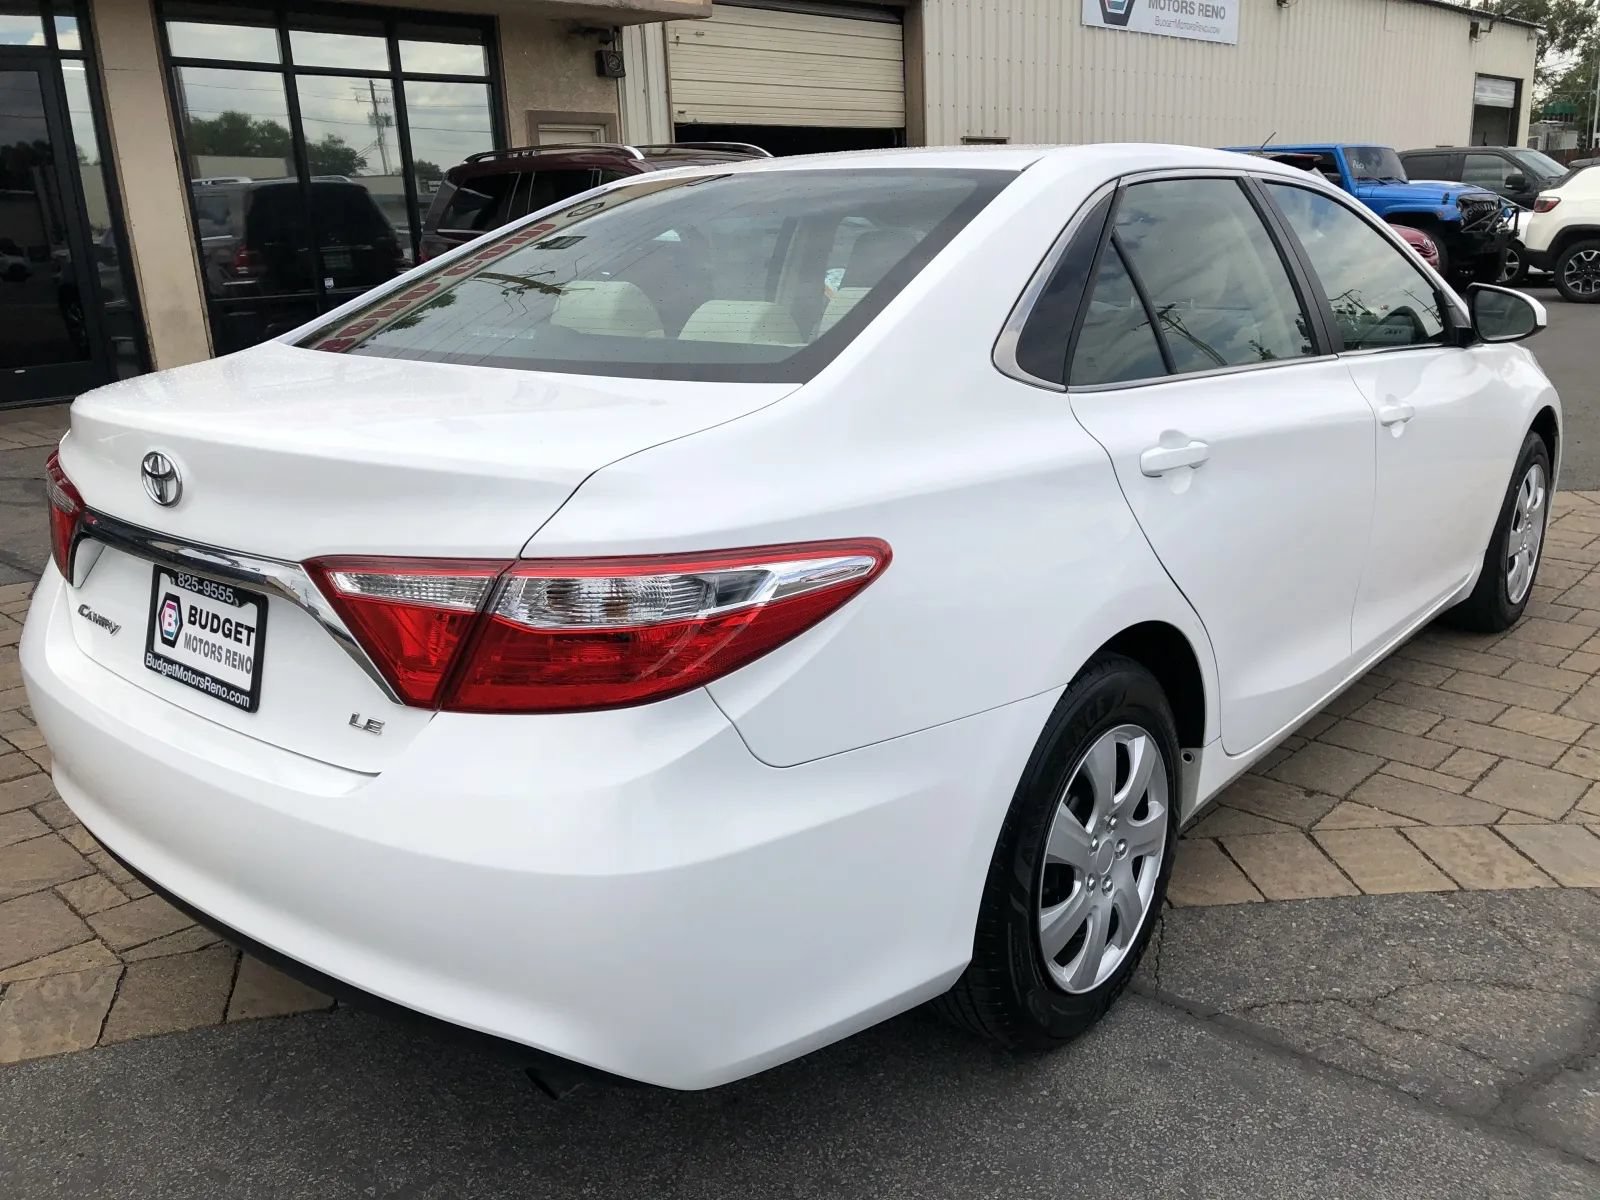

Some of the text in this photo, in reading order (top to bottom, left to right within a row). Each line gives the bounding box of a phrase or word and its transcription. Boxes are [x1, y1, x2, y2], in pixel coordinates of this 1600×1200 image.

[1148, 0, 1226, 20] MOTORS RENO
[177, 572, 234, 603] 825-9555
[187, 605, 255, 647] BUDGET
[184, 632, 253, 675] MOTORS RENO
[145, 653, 250, 708] BudgetMotorsReno.com
[348, 711, 385, 736] LE
